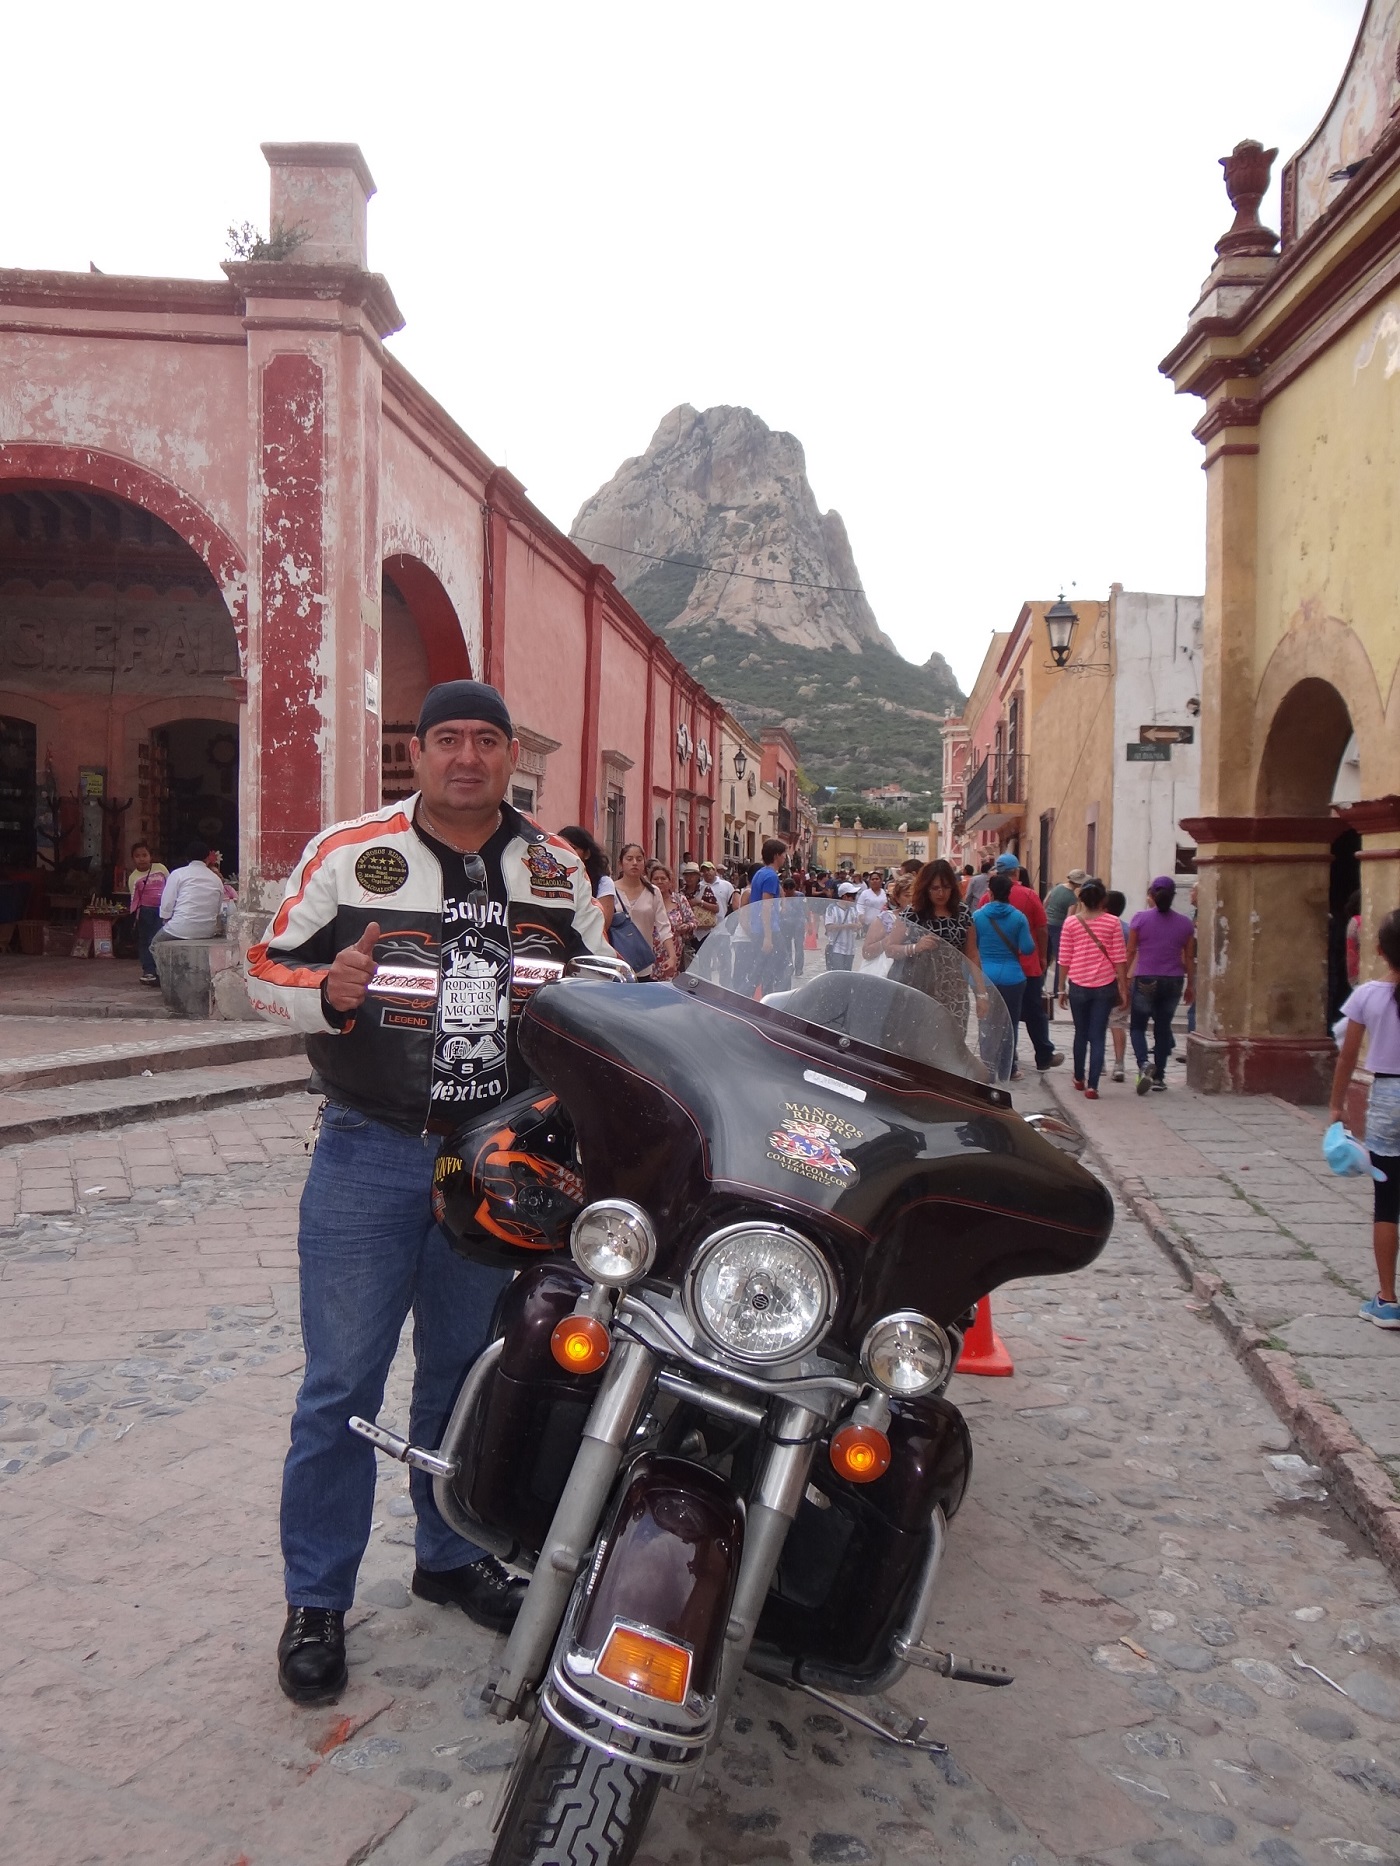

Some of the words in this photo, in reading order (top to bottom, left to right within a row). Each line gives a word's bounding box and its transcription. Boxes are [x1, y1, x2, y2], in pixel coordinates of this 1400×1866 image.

[0, 615, 239, 676] SMERAL
[465, 936, 478, 948] N
[388, 1014, 428, 1026] LEGEND
[461, 1063, 474, 1074] S
[784, 1102, 864, 1139] MAÑOSOS
[792, 1111, 854, 1139] RIDERS
[766, 1151, 848, 1188] COATZACOALCOS
[780, 1162, 832, 1187] VERACRUZ
